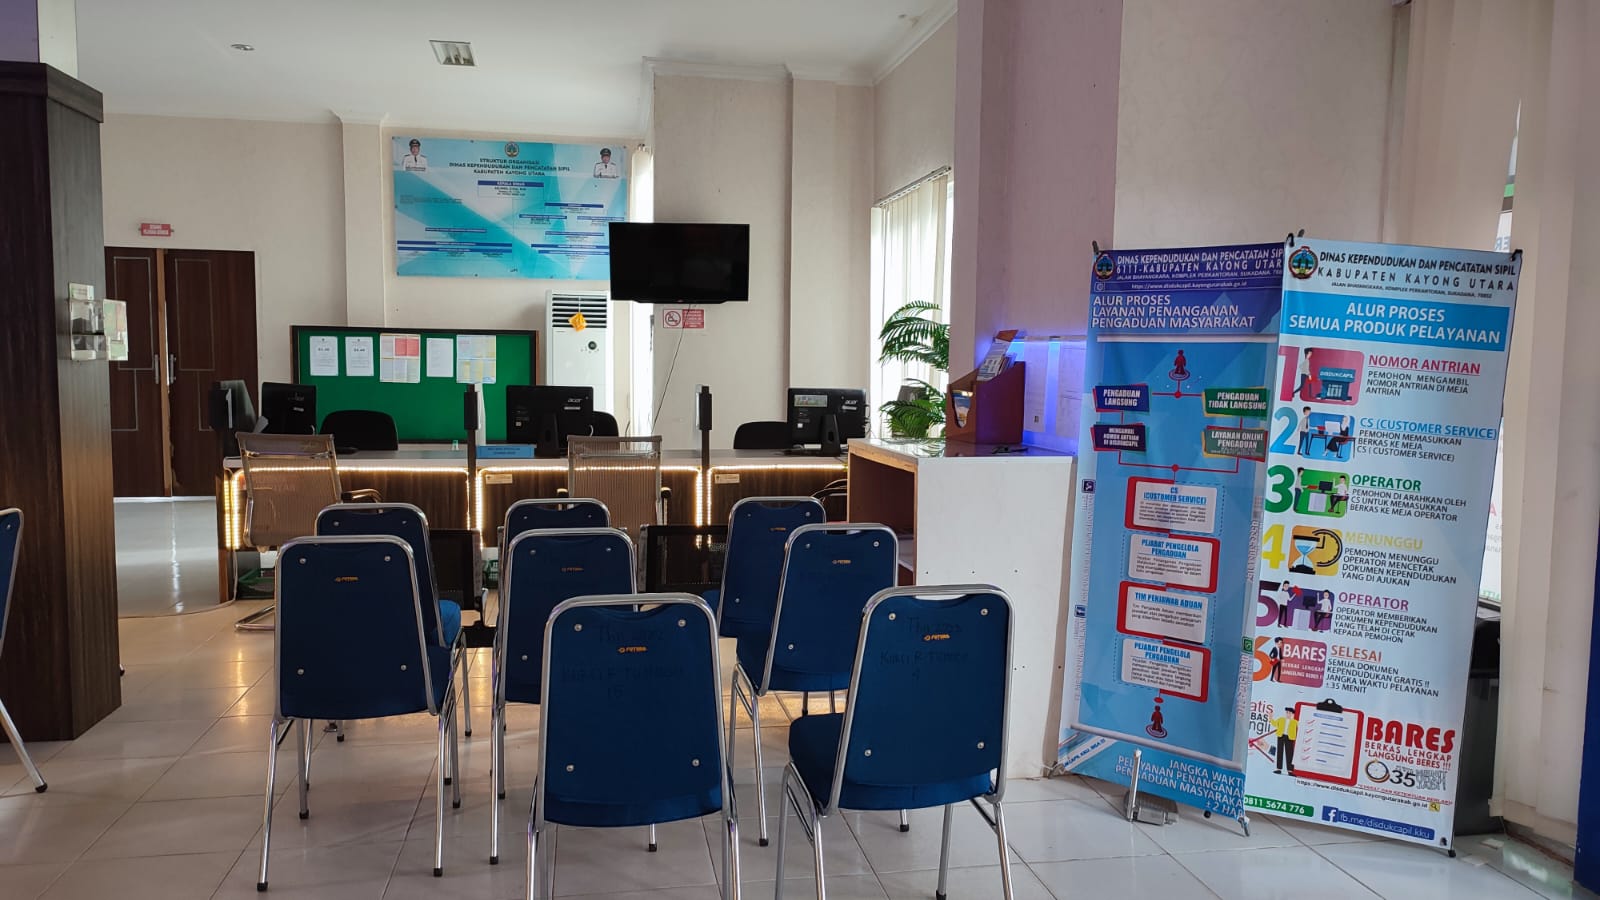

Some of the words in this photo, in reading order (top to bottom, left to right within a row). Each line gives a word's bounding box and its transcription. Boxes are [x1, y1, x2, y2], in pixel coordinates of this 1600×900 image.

[1118, 255, 1138, 264] DINAS
[1141, 252, 1199, 263] KEPENDUDUKAN
[1202, 252, 1217, 260] DAN
[1220, 250, 1268, 259] PENCATATAN
[1206, 261, 1248, 270] KAYONG
[1320, 252, 1346, 263] DINAS
[1347, 254, 1416, 268] KEPENDUDUKAN
[1419, 259, 1437, 270] DAN
[1440, 260, 1492, 274] PENCATATAN
[1495, 264, 1516, 276] SIPIL
[1318, 267, 1396, 282] KABUPATEN
[1405, 273, 1460, 286] KAYONG
[1469, 278, 1513, 290] UTARA
[1094, 296, 1123, 305] ALUR
[1126, 295, 1170, 305] PROSES
[1093, 307, 1145, 316] LAYANAN
[1149, 306, 1238, 316] PENANGANAN
[1347, 302, 1384, 318] ALUR
[1389, 305, 1445, 322] PROSES
[1092, 318, 1165, 328] PENGADUAN
[1169, 316, 1255, 328] MASYARAKAT
[1290, 315, 1340, 331] SEMUA
[1344, 319, 1405, 336] PRODUK
[1410, 324, 1500, 343] PELAYANAN
[1369, 355, 1418, 370] NOMOR
[1422, 359, 1480, 374] ANTRIAN
[1278, 346, 1299, 402] 1
[1368, 371, 1411, 381] PEMOHON
[1417, 374, 1469, 386] MENGAMBIL
[1104, 389, 1140, 398] PENGADUAN
[1366, 387, 1400, 396] ANTRIAN
[1367, 380, 1397, 388] NOMOR
[1399, 382, 1434, 391] ANTRIAN
[1436, 384, 1444, 392] DI
[1446, 385, 1468, 394] MEJA
[1105, 398, 1137, 406] LANGSUNG
[1209, 399, 1228, 408] TIDAK
[1230, 400, 1266, 409] LANGSUNG
[1217, 392, 1259, 401] PENGADUAN
[1212, 430, 1240, 440] LAYANAN
[1269, 407, 1298, 454] 2
[1360, 418, 1374, 428] CS
[1377, 419, 1441, 435] (CUSTOMER
[1445, 425, 1497, 440] SERVICE)
[1360, 430, 1400, 440] PEMOHON
[1402, 434, 1461, 445] MEMASUKKAN
[1218, 440, 1256, 448] PENGADUAN
[1358, 438, 1388, 447] BERKAS
[1401, 442, 1422, 450] MEJA
[1357, 446, 1367, 454] CS
[1419, 452, 1455, 462] SERVICE)
[1265, 465, 1295, 513] 3
[1352, 475, 1421, 491] OPERATOR
[1351, 496, 1360, 504] CS
[1362, 497, 1388, 507] UNTUK
[1390, 500, 1447, 512] MEMASUKKAN
[1352, 489, 1391, 499] PEMOHON
[1403, 494, 1442, 504] ARAHKAN
[1445, 498, 1466, 507] OLEH
[1350, 504, 1379, 514] BERKAS
[1381, 507, 1389, 515] KE
[1391, 508, 1412, 517] MEJA
[1414, 510, 1457, 521] OPERATOR
[1262, 524, 1286, 569] 4
[1345, 532, 1423, 550] MENUNGGU
[1344, 556, 1386, 567] OPERATOR
[1388, 561, 1433, 573] MENCETAK
[1345, 548, 1385, 559] PEMOHON
[1388, 553, 1439, 565] MENUNGGU
[1341, 572, 1364, 582] YANG
[1366, 575, 1374, 583] DI
[1376, 576, 1410, 587] AJUKAN
[1343, 564, 1383, 576] DOKUMEN
[1386, 569, 1456, 584] KEPENDUDUKAN
[1135, 592, 1147, 601] TIM
[1256, 580, 1281, 627] 5
[1339, 592, 1408, 611] OPERATOR
[1335, 614, 1373, 625] DOKUMEN
[1375, 619, 1437, 633] KEPENDUDUKAN
[1337, 607, 1375, 618] OPERATOR
[1377, 612, 1427, 624] MEMBERIKAN
[1334, 621, 1356, 630] YANG
[1358, 624, 1380, 633] TELAH
[1392, 628, 1415, 638] CETAK
[1334, 629, 1362, 638] KEPADA
[1365, 632, 1403, 643] PEMOHON
[1253, 636, 1273, 681] 6
[1283, 644, 1325, 662] BARES
[1331, 645, 1381, 662] SELESAI
[1328, 659, 1355, 669] SEMUA
[1358, 663, 1398, 674] DOKUMEN
[1326, 674, 1357, 684] JANGKA
[1360, 678, 1388, 689] WAKTU
[1390, 682, 1439, 696] PELAYANAN
[1327, 667, 1389, 682] KEPENDUDUKAN
[1395, 676, 1423, 686] GRATIS
[1342, 684, 1366, 693] MENIT
[1366, 717, 1455, 753] BARES
[1365, 741, 1400, 754] BERKAS
[1408, 747, 1452, 761] LENGKAP
[1118, 755, 1173, 779] PELYANAN
[1170, 759, 1208, 777] JANGKA
[1416, 757, 1441, 768] BERES
[1390, 770, 1415, 787] 35
[1213, 802, 1218, 811] 2
[1266, 800, 1286, 812] 5674
[1289, 805, 1305, 816] 776
